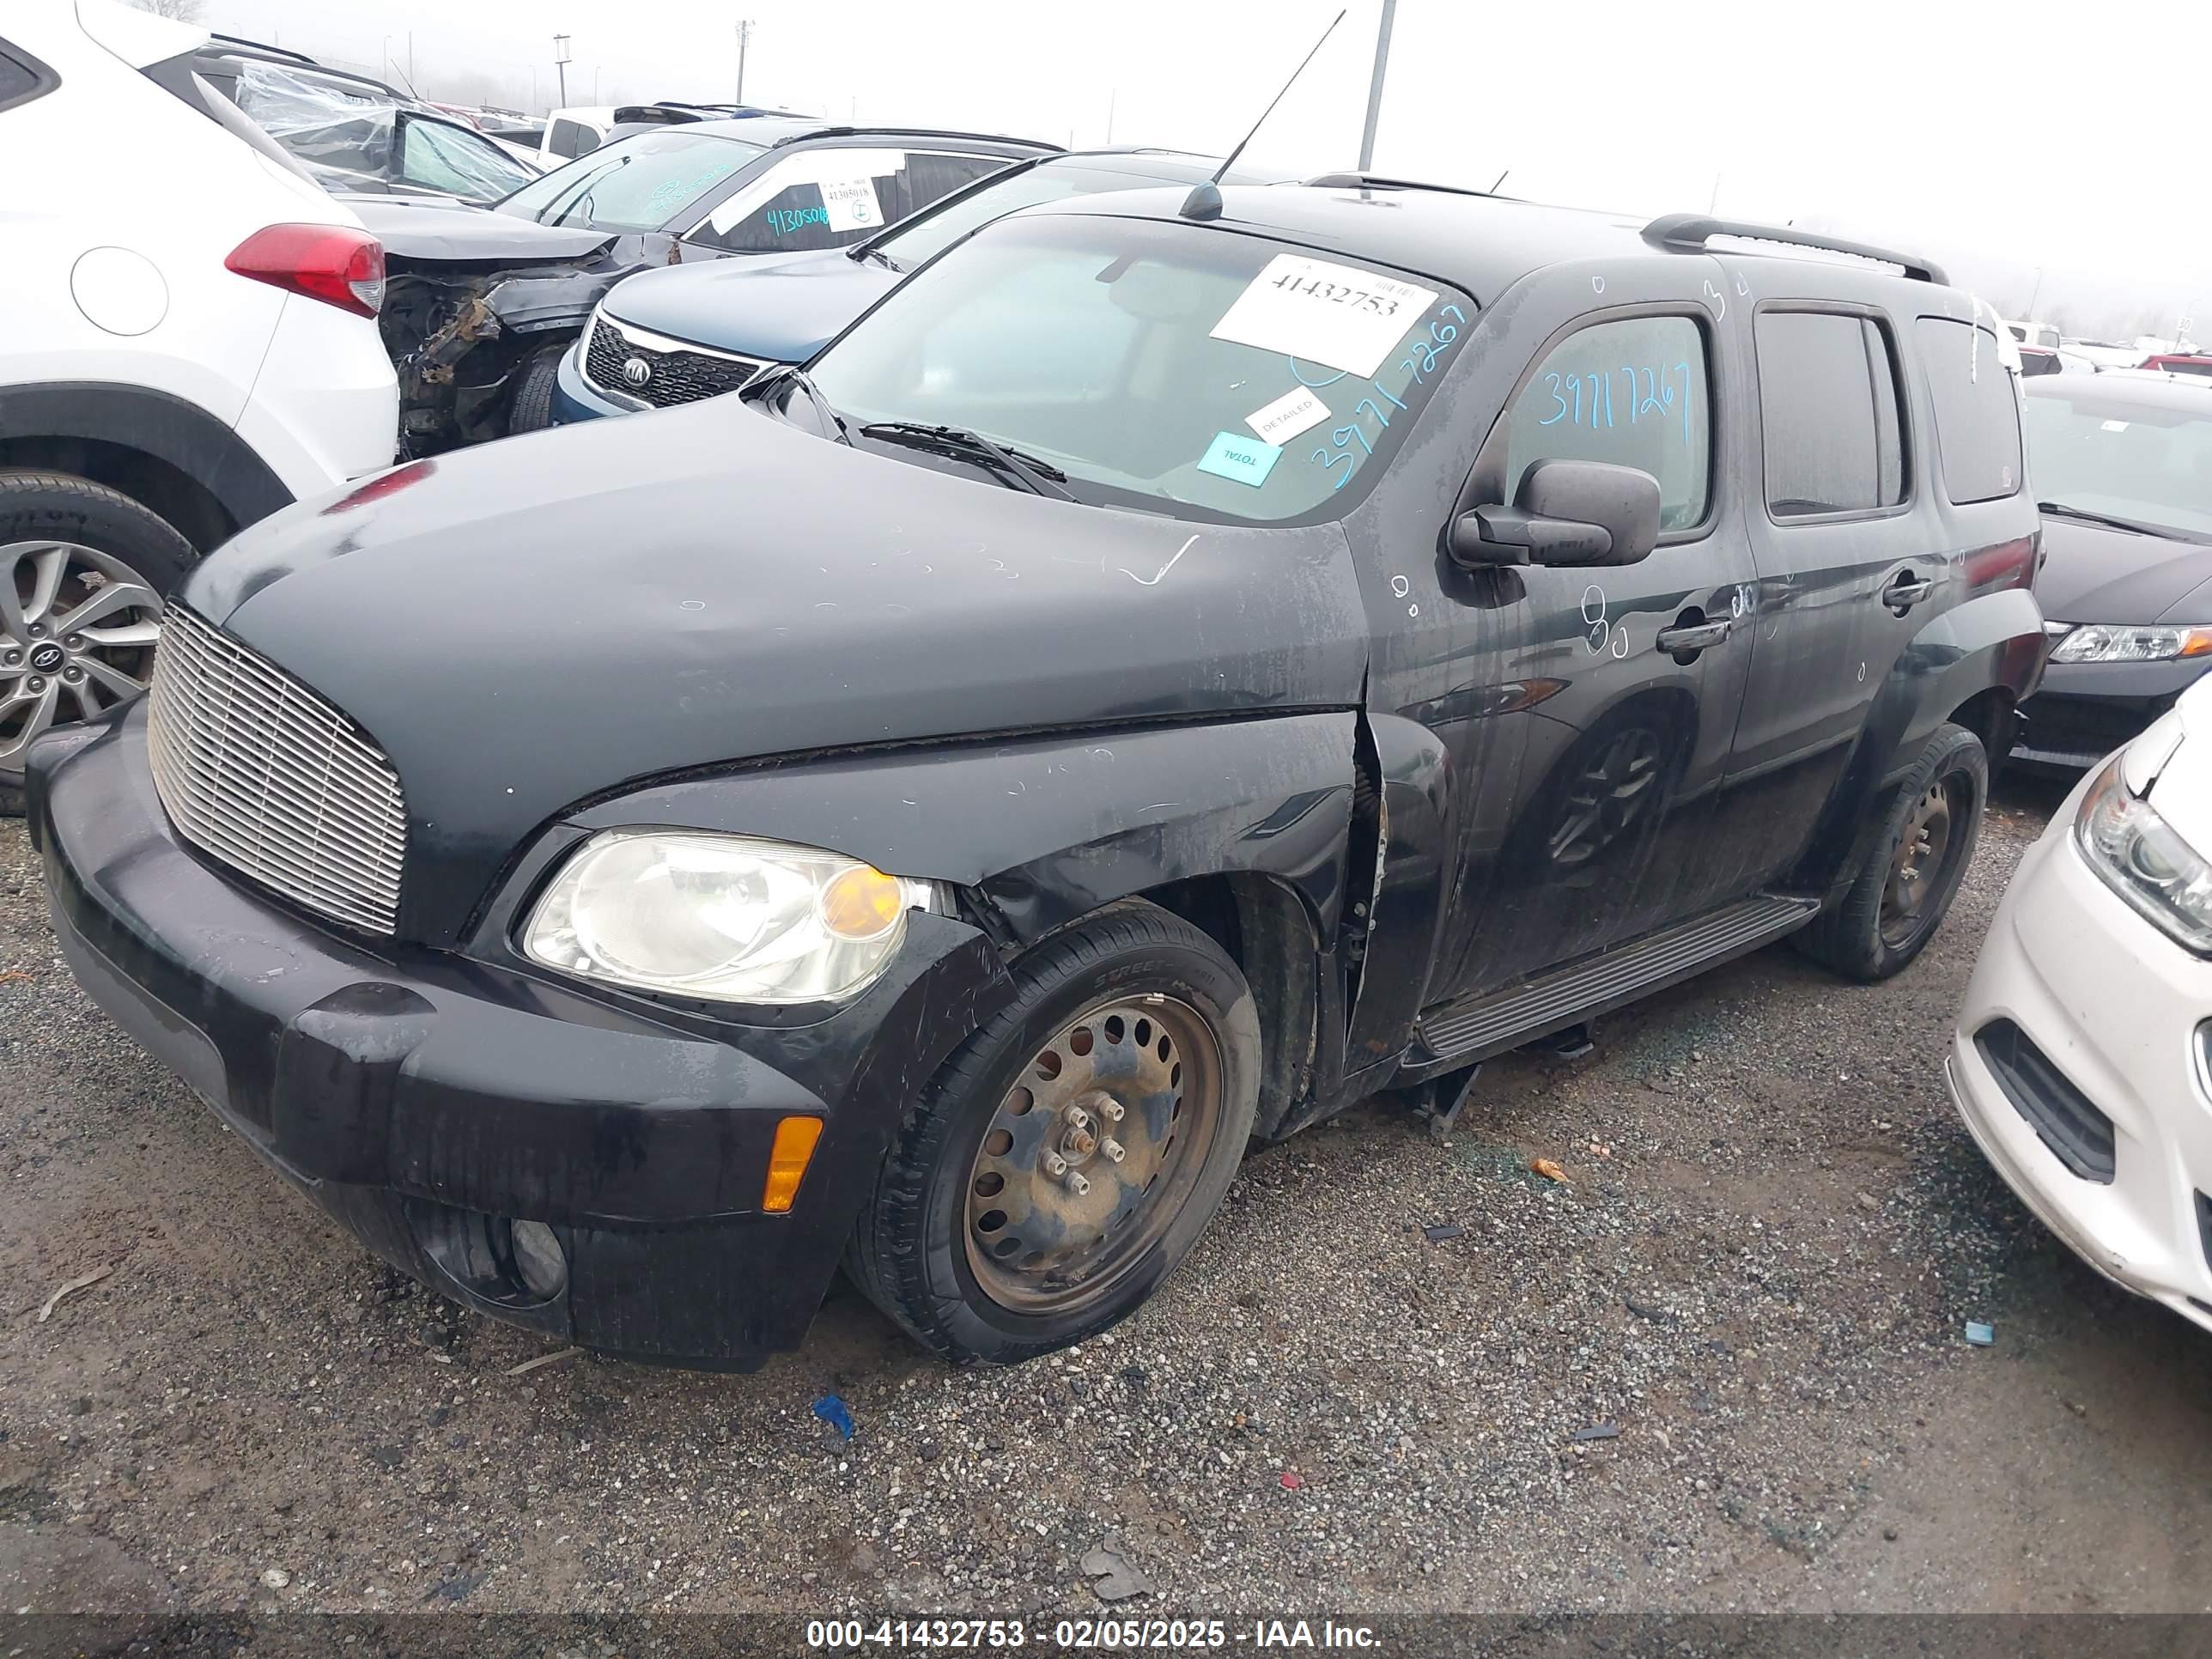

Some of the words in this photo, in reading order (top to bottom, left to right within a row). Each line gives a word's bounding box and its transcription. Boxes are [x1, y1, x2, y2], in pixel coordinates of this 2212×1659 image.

[829, 187, 870, 200] 41305018
[1272, 265, 1399, 316] 41432753
[625, 362, 643, 382] KIA
[1262, 400, 1312, 433] DETAILED
[1224, 449, 1256, 466] TOTAL
